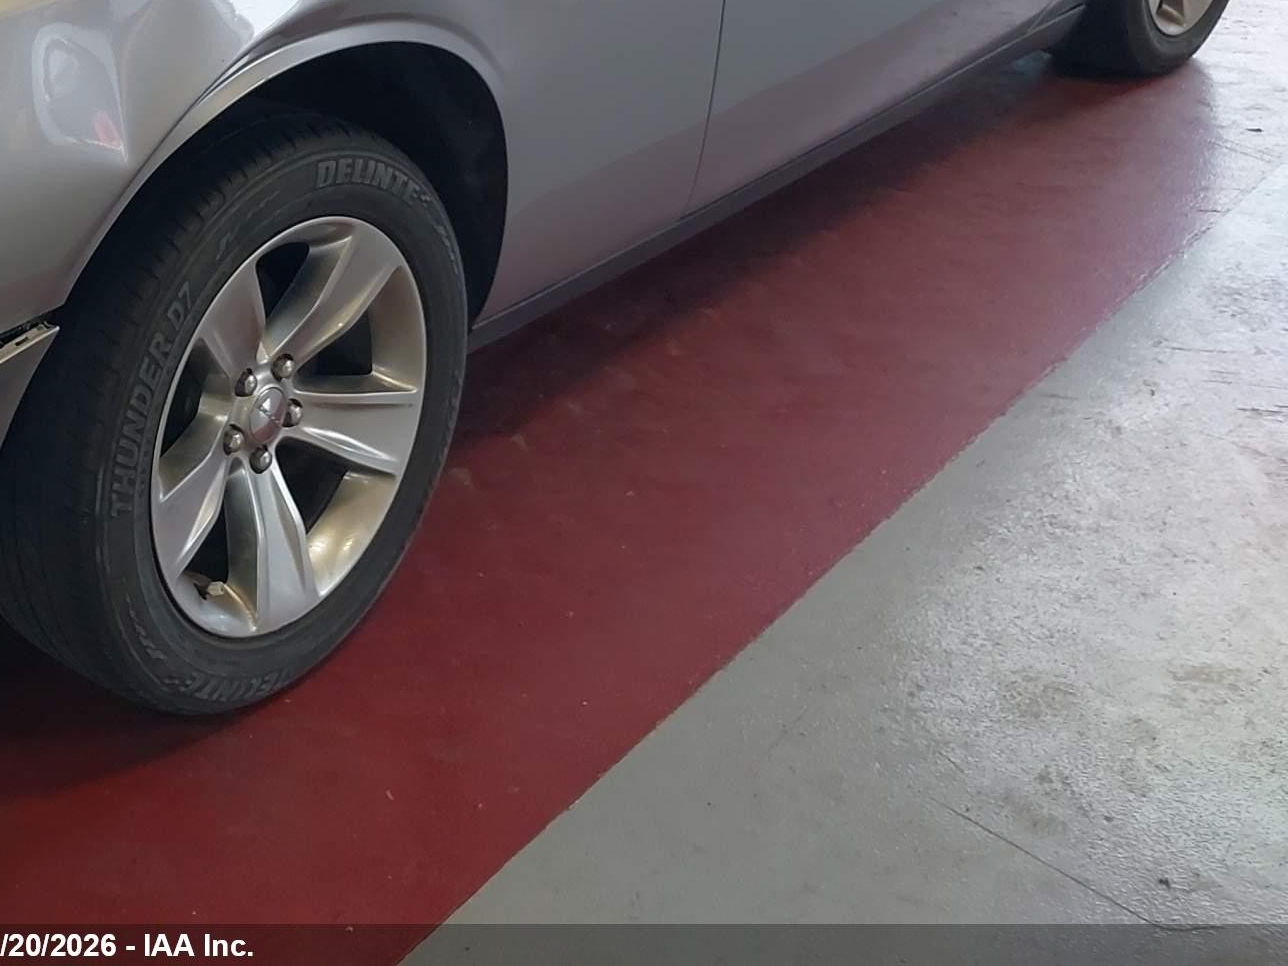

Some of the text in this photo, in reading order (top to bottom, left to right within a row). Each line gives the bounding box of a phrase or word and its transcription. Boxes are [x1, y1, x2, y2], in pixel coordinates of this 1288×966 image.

[315, 158, 420, 204] DELINTE
[110, 281, 193, 518] THUNDER D7
